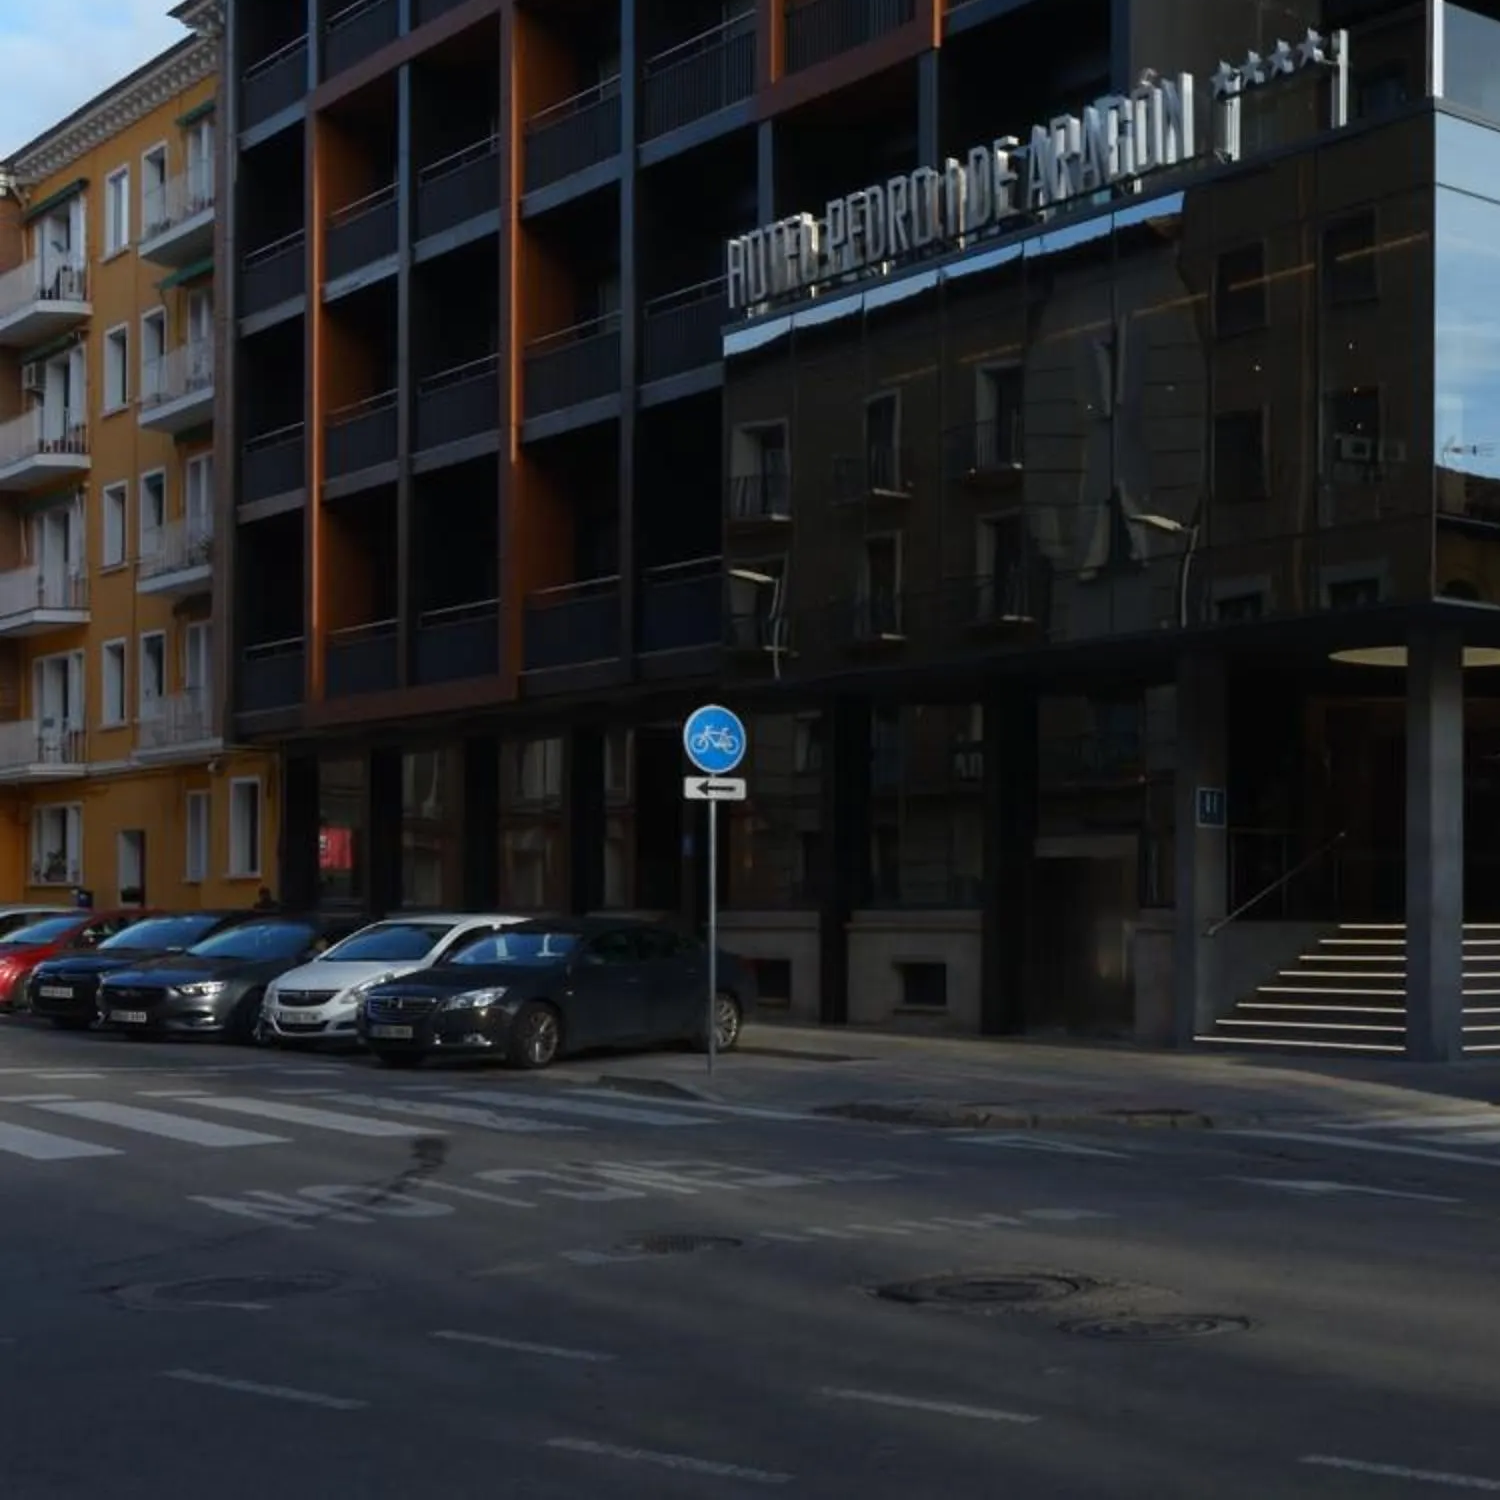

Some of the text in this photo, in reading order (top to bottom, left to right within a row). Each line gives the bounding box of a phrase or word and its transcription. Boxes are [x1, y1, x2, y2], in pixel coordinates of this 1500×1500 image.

[727, 212, 820, 308] HOTEL
[826, 166, 940, 276] PEDRO
[967, 136, 1019, 230] DE
